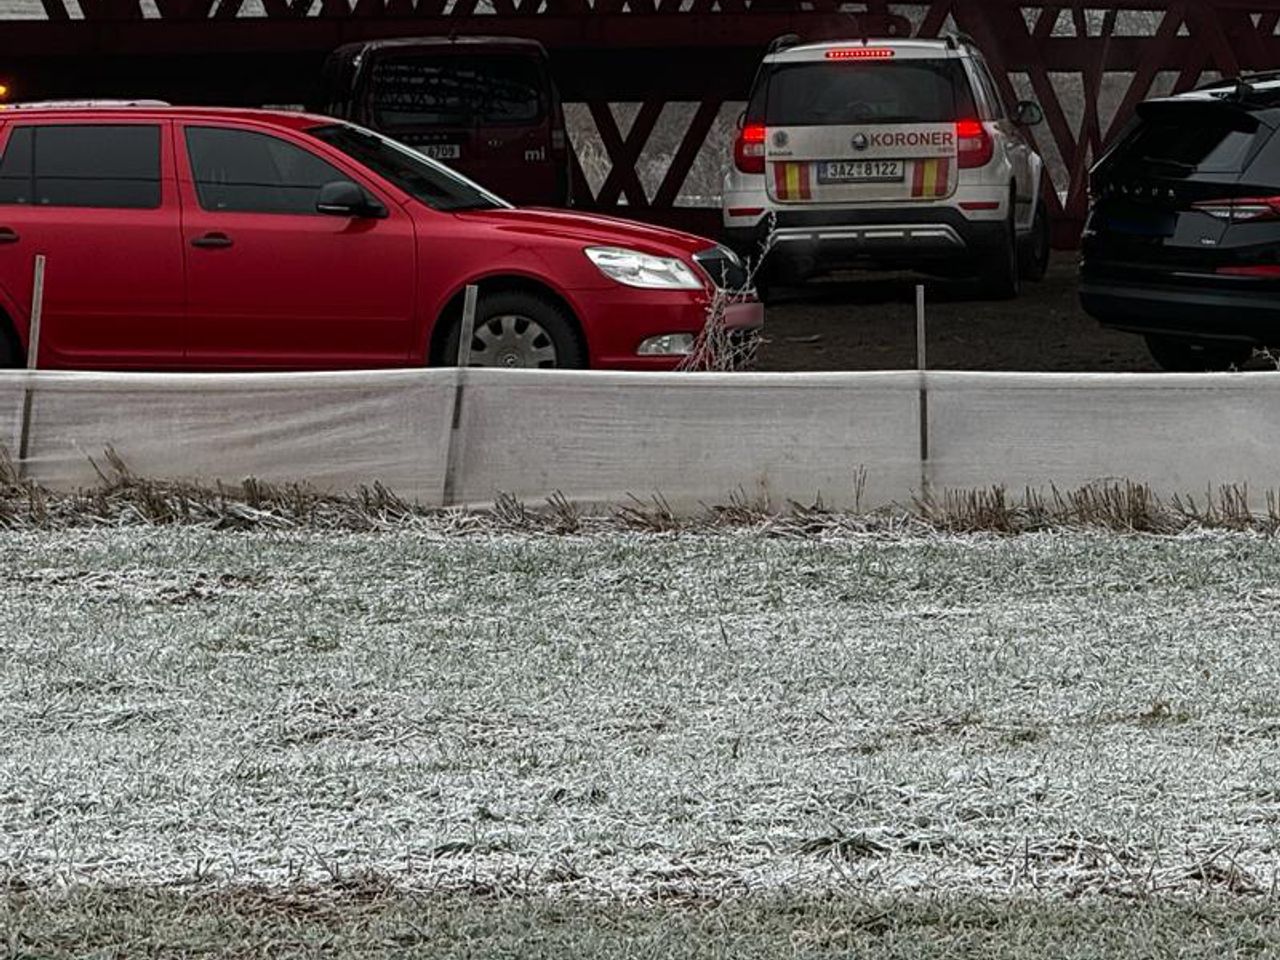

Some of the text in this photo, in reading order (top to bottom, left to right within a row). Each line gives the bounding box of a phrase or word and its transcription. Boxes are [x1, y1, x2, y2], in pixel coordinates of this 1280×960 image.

[870, 132, 953, 146] KORONER
[525, 146, 546, 161] mi
[830, 162, 898, 177] 3AZ 8122
